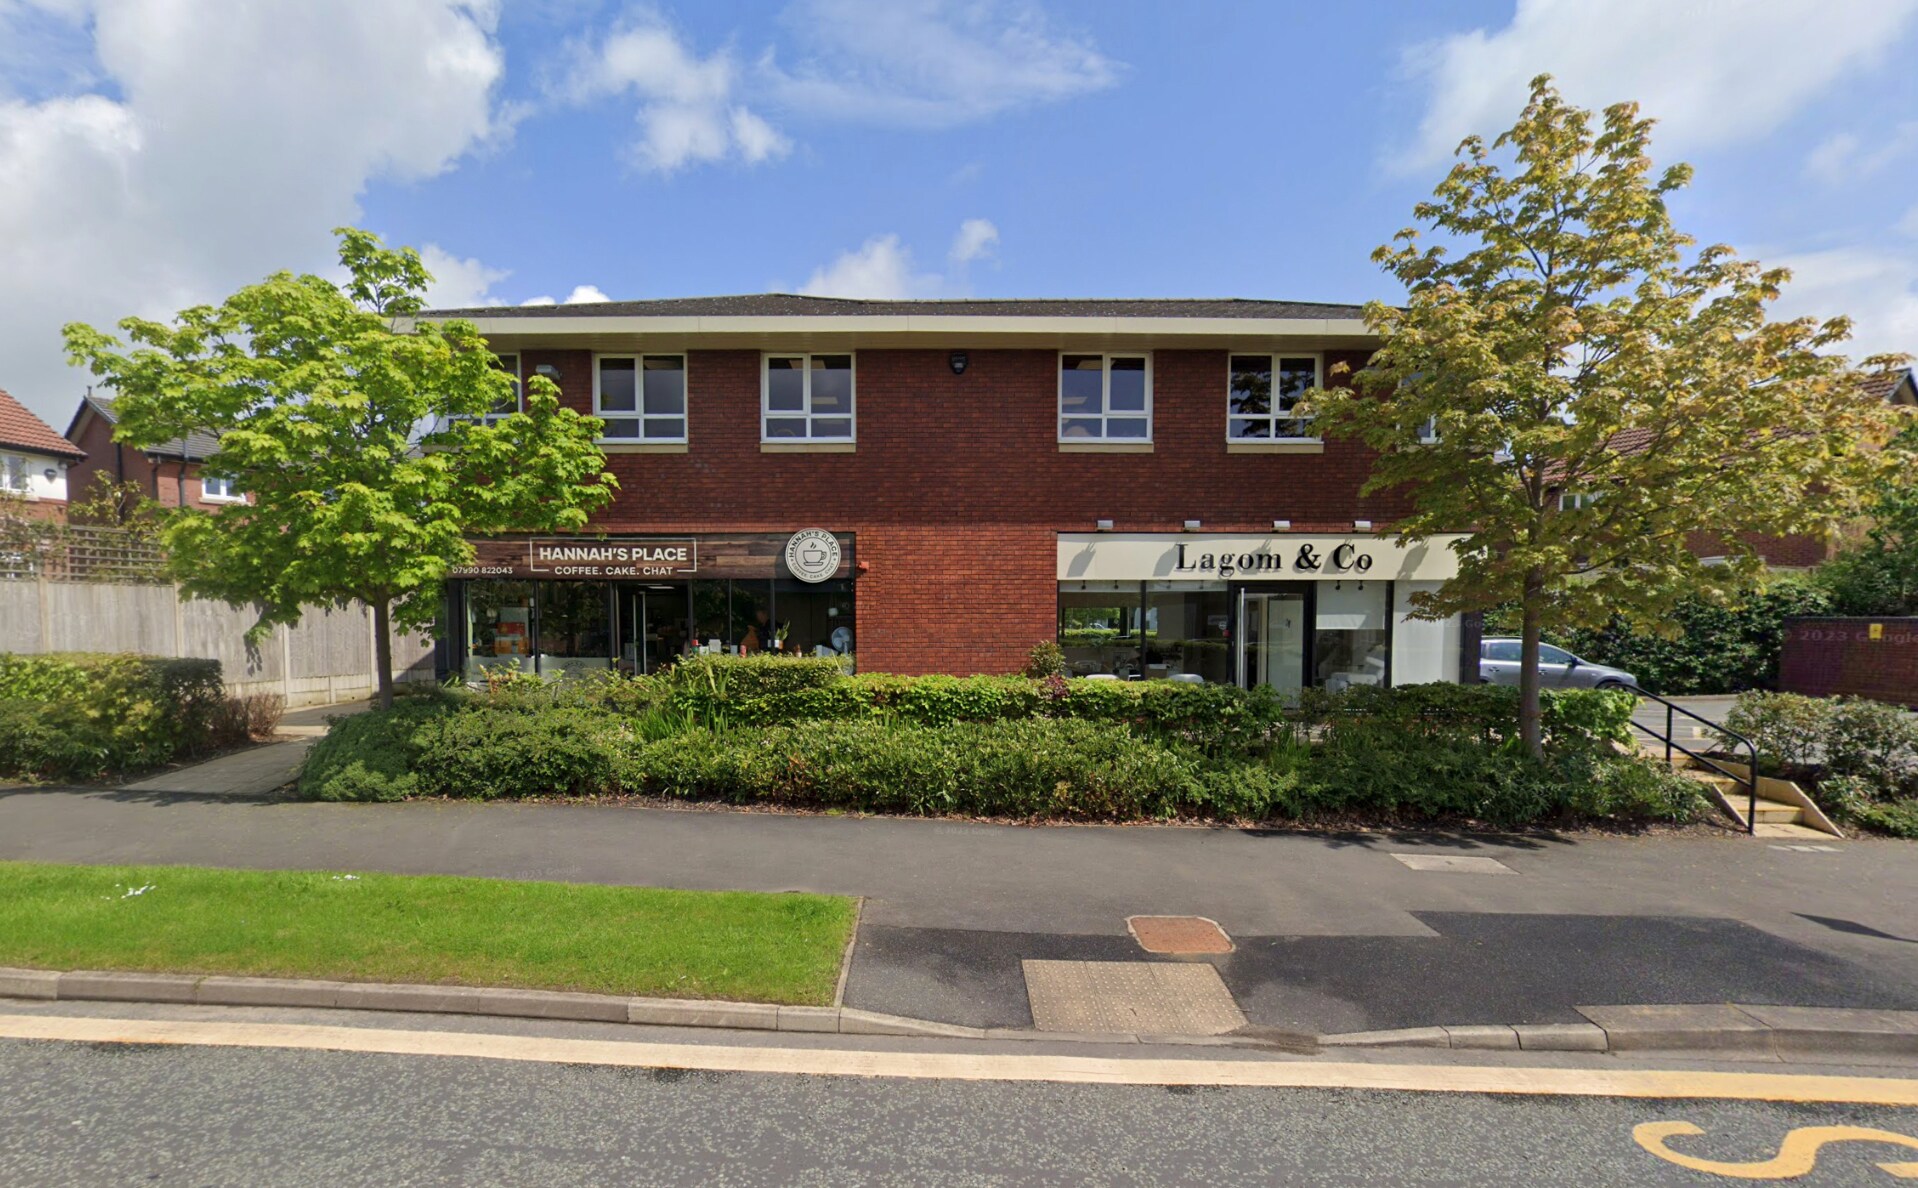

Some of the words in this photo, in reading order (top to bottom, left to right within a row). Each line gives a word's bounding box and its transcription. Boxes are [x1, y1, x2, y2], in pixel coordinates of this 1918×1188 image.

[789, 531, 820, 558] HANNAH'S
[821, 533, 838, 557] PLACE
[539, 547, 628, 562] HANNAH'S
[632, 547, 687, 561] PLACE
[1176, 543, 1282, 577] Lagom
[1295, 543, 1322, 569] &
[1333, 543, 1373, 570] Co
[481, 566, 513, 574] 822043
[555, 567, 602, 575] COFFEE.
[605, 567, 640, 575] CAKE.
[644, 567, 673, 575] CHAT
